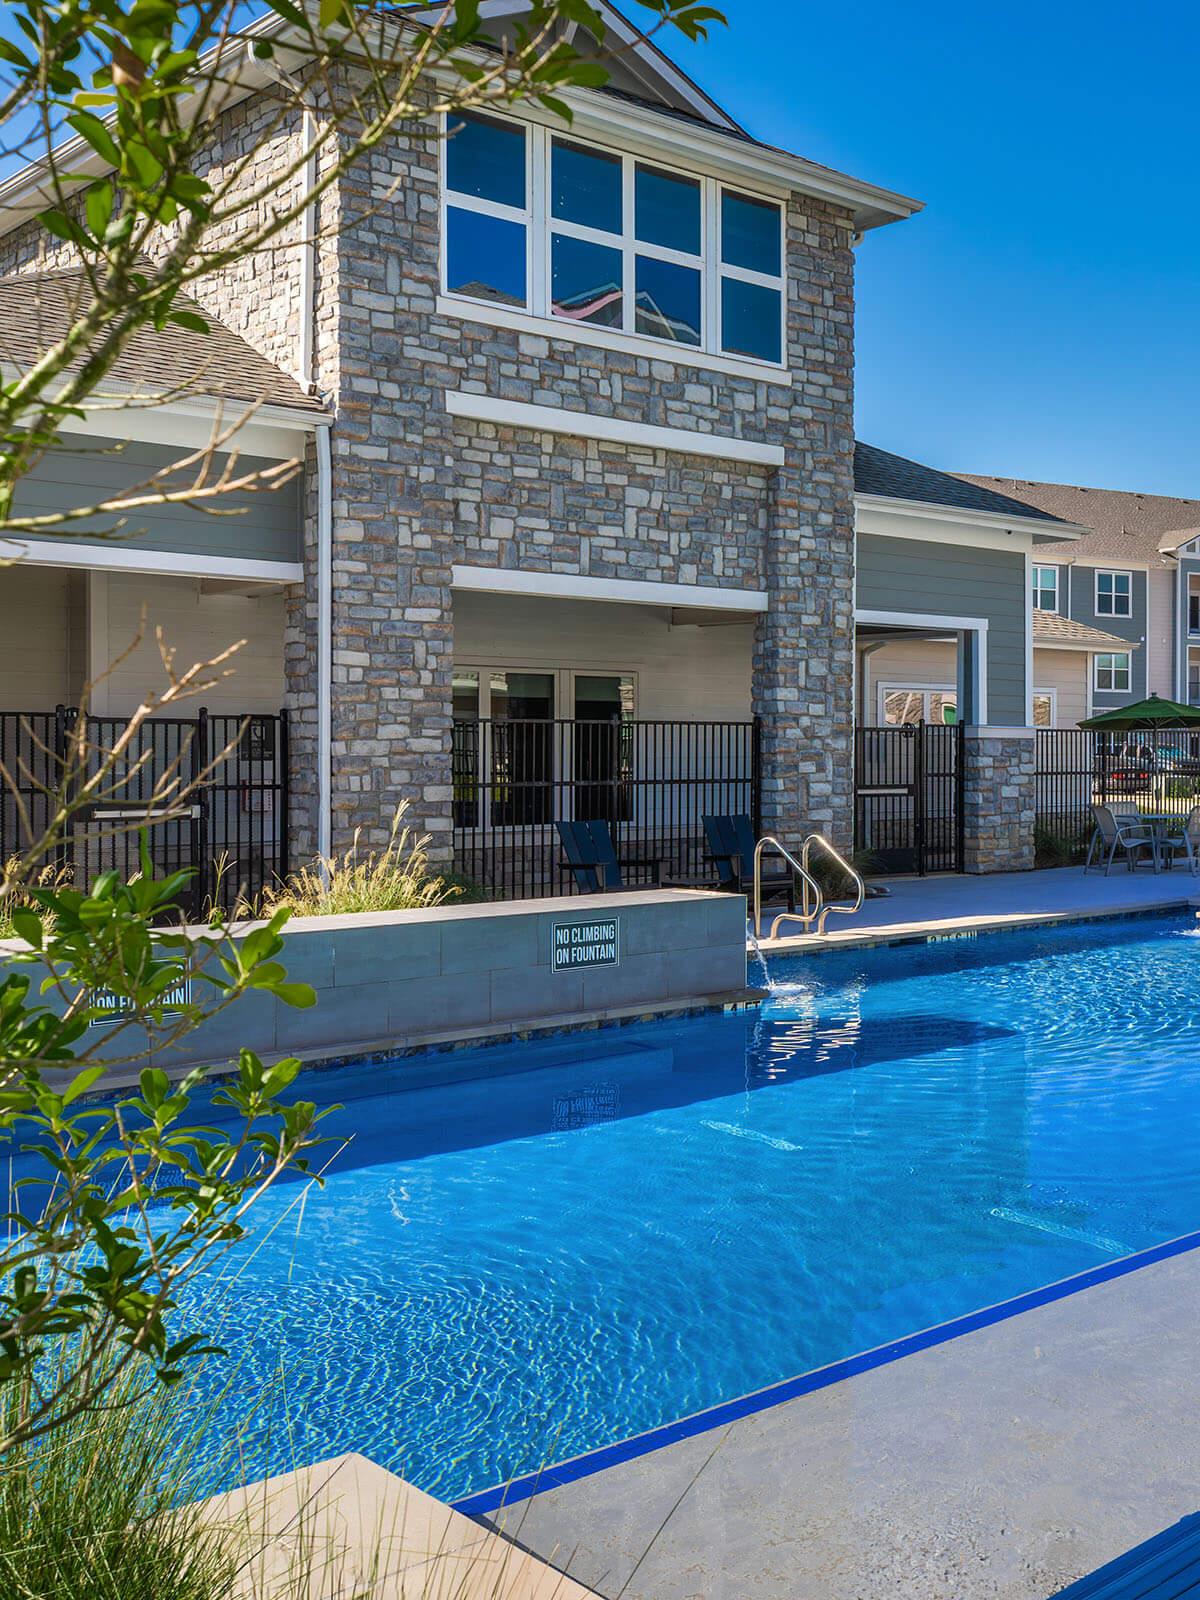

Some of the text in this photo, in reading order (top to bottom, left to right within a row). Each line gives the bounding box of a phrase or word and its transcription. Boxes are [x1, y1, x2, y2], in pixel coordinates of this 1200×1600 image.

[556, 924, 615, 945] NO CLIMBING
[556, 943, 615, 964] ON FOUNTAIN
